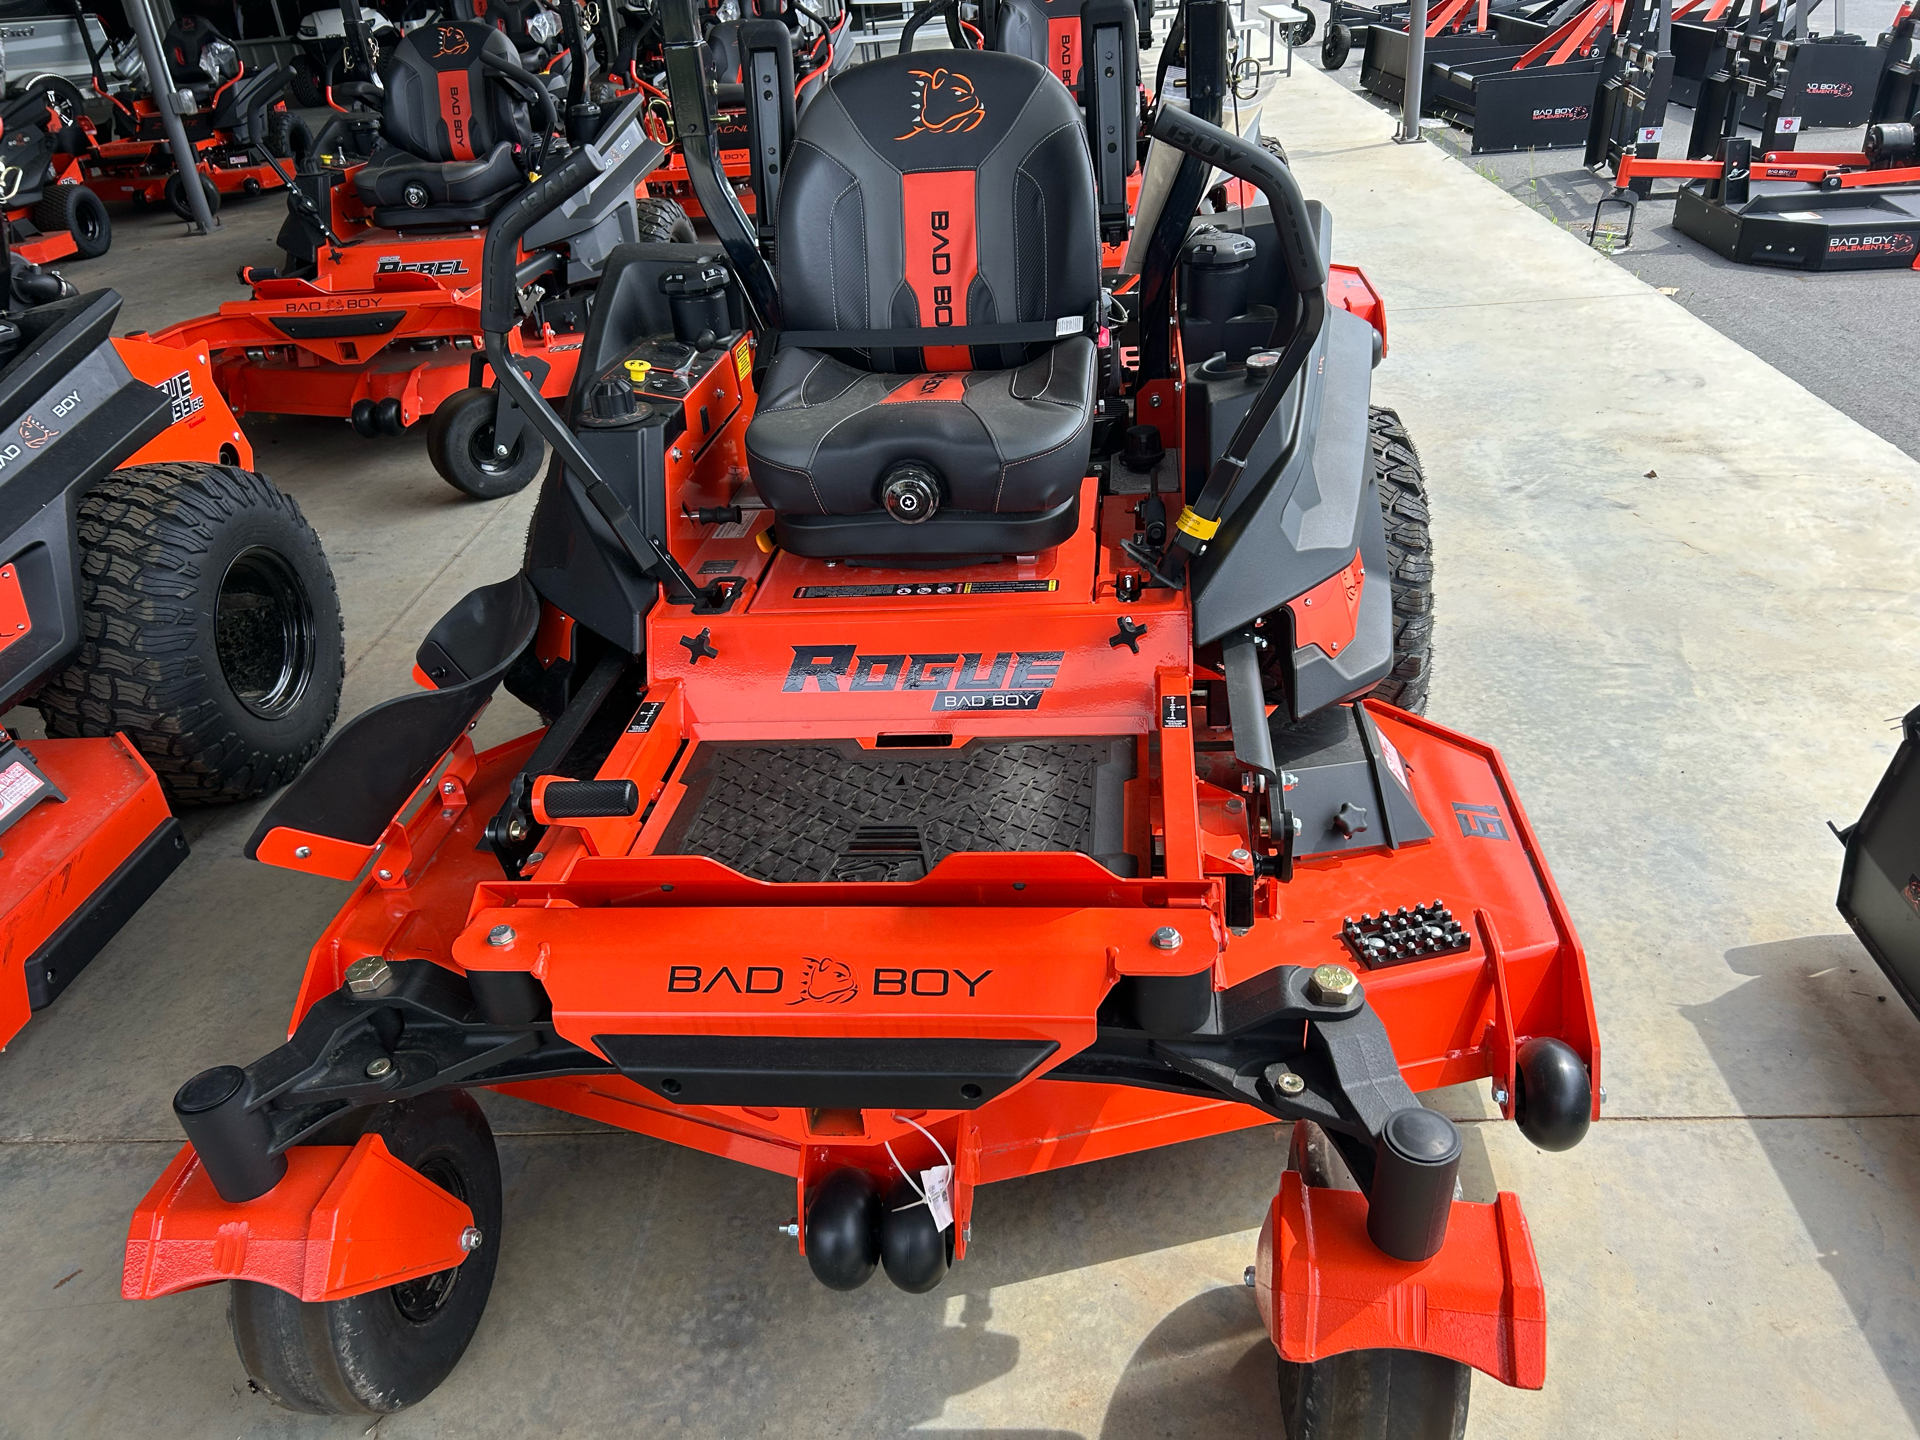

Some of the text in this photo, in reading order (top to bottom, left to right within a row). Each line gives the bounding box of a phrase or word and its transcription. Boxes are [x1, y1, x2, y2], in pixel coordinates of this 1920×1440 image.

[1061, 35, 1072, 86] BAD BO
[1806, 82, 1819, 90] AD
[449, 86, 466, 148] BAD BOY
[1554, 107, 1575, 115] BOY
[1165, 120, 1249, 167] BOY
[520, 162, 580, 218] BAD
[1828, 243, 1891, 253] IMPLEMENTS
[1829, 235, 1893, 247] BAD BOY
[931, 210, 953, 327] BAD BO
[285, 297, 383, 313] BAD BOY
[0, 390, 82, 470] AD BOY
[781, 644, 1066, 693] ROGUE
[943, 693, 1035, 708] BAD BOY
[667, 965, 994, 998] BAD BOY
